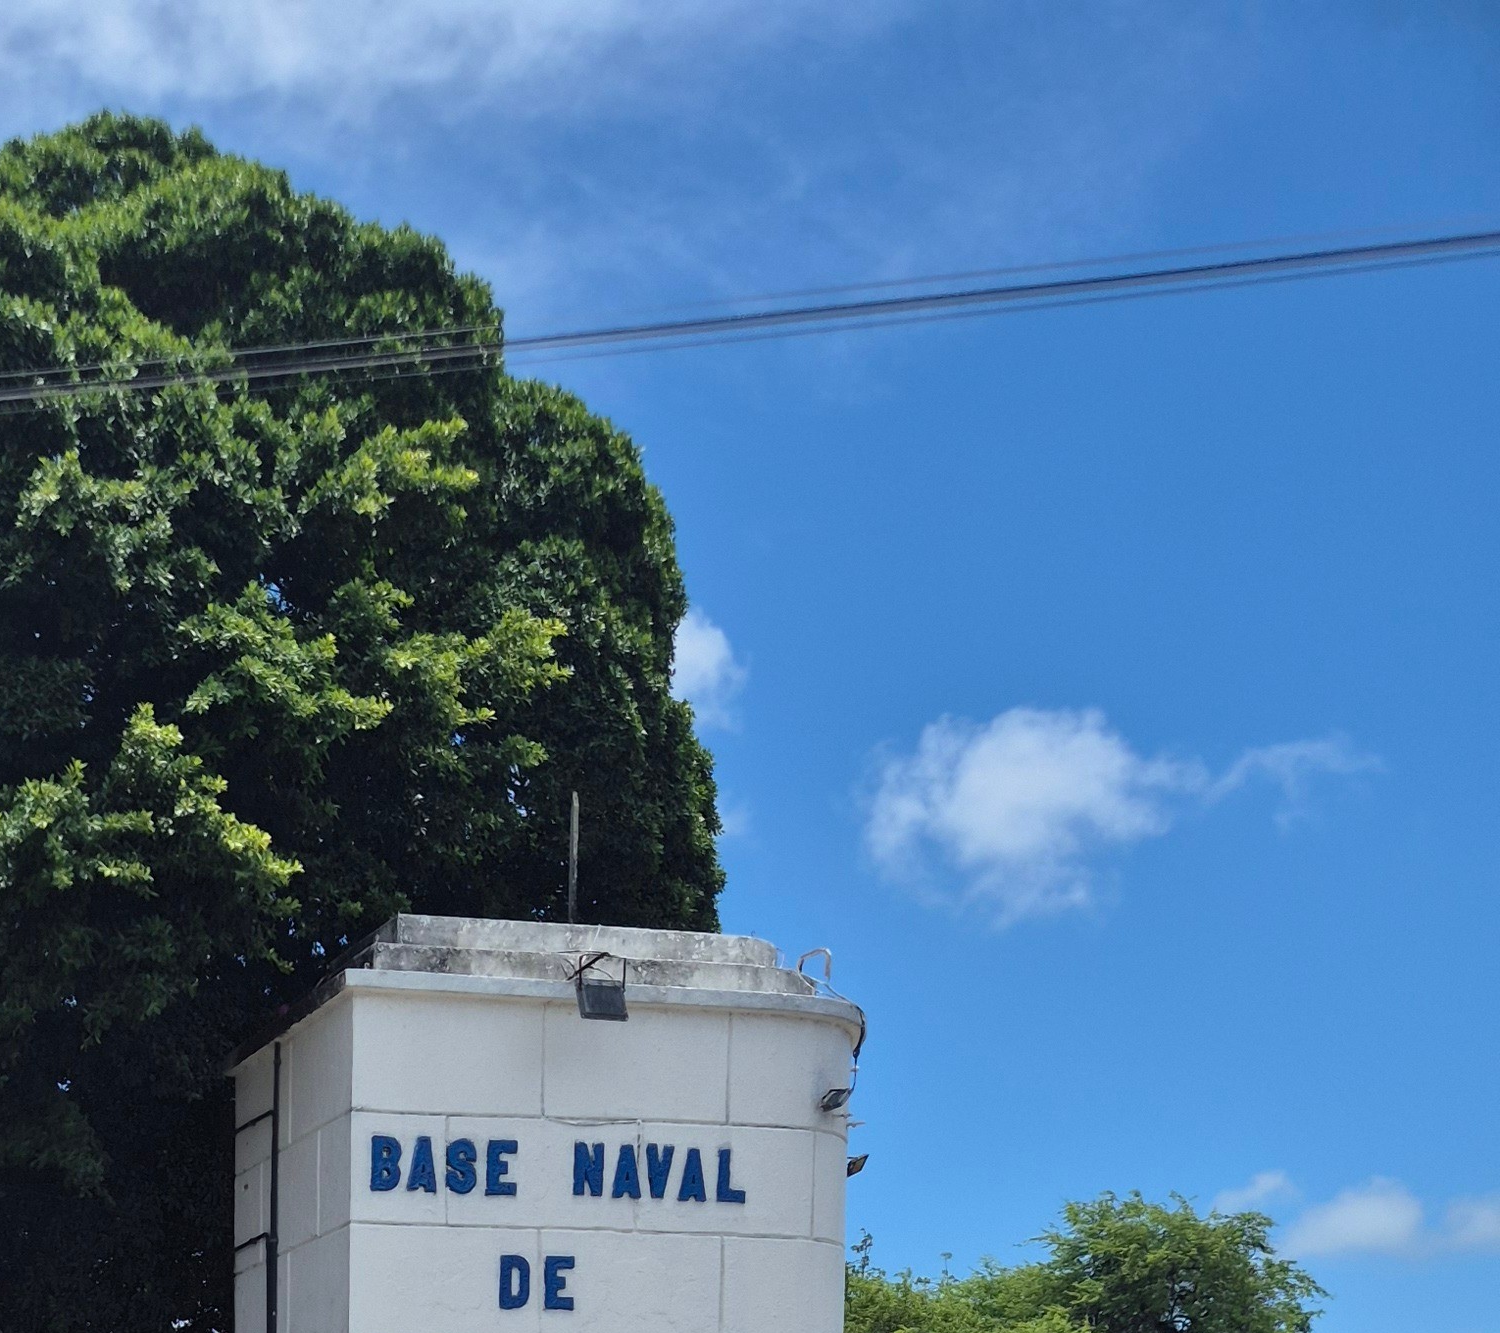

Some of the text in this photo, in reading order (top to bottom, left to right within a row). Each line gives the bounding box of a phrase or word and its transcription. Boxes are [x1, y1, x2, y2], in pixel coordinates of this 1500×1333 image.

[369, 1134, 747, 1205] BASE NAVAL
[498, 1254, 576, 1311] DE
